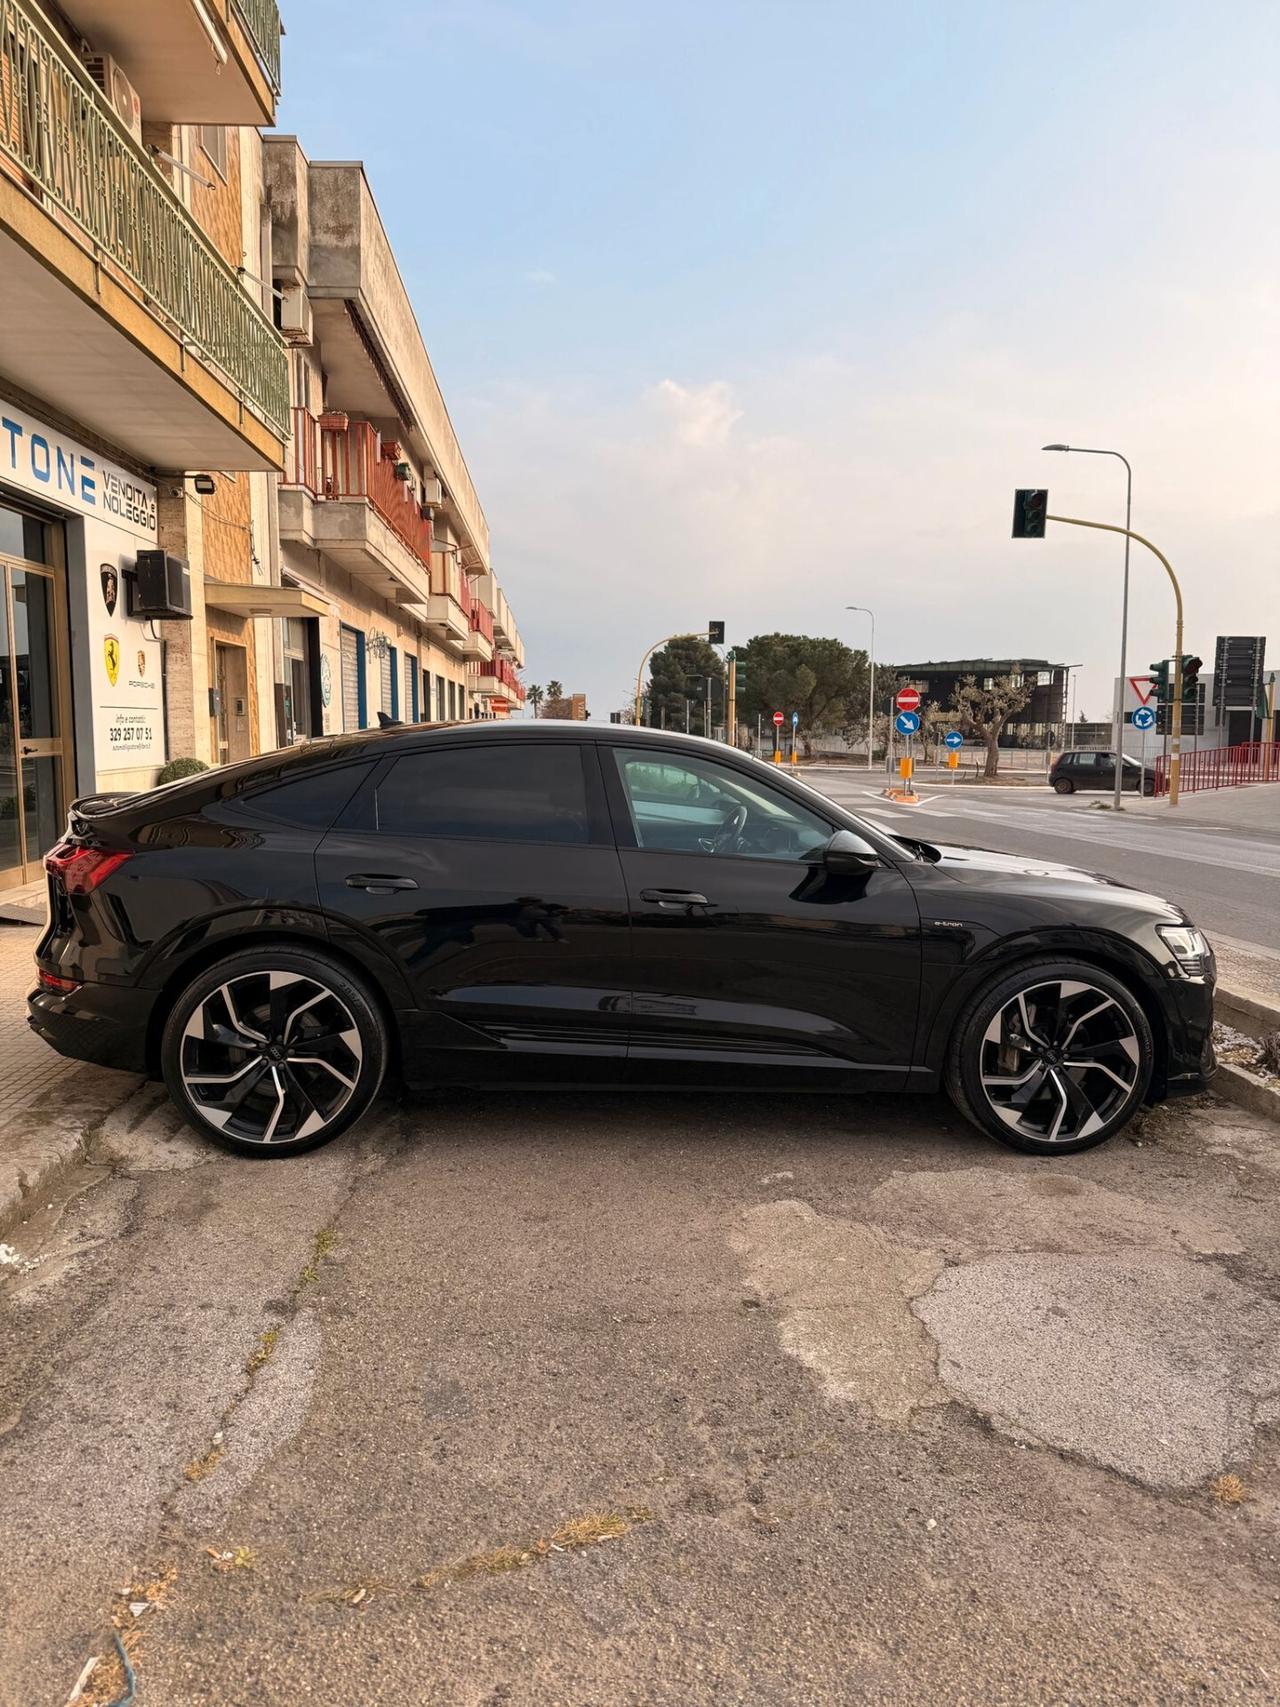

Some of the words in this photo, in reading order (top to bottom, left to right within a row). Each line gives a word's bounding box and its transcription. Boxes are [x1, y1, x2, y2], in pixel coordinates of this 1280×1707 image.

[2, 416, 96, 505] TONE
[103, 470, 148, 510] VENDITA
[103, 491, 156, 531] NOLEGGIO
[128, 680, 155, 689] PORSCHE
[109, 727, 121, 742] 329
[123, 727, 134, 741] 257
[135, 727, 143, 741] 07
[145, 727, 152, 741] 51
